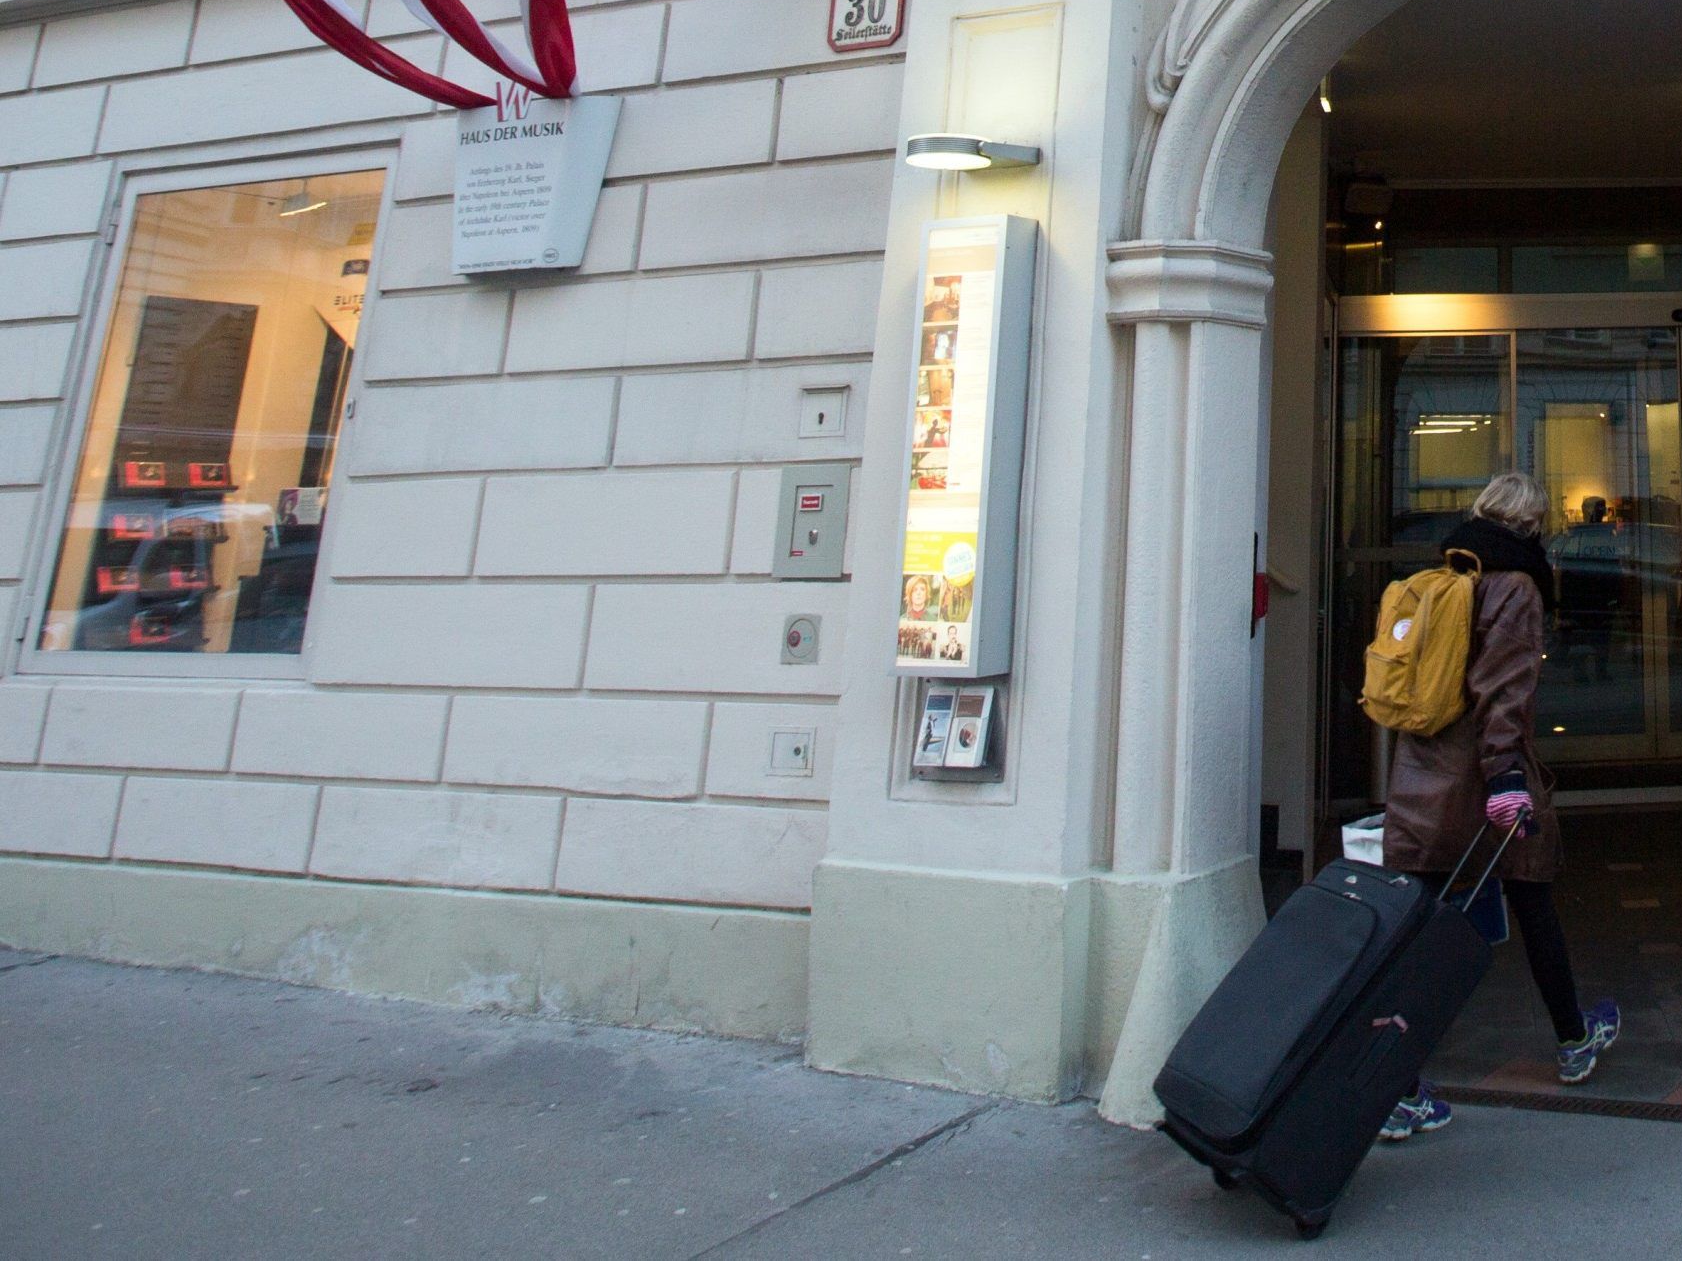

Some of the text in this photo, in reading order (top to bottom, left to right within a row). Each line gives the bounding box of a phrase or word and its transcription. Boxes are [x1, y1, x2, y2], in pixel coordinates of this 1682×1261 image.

[460, 122, 565, 145] HAUS DER MUSIK
